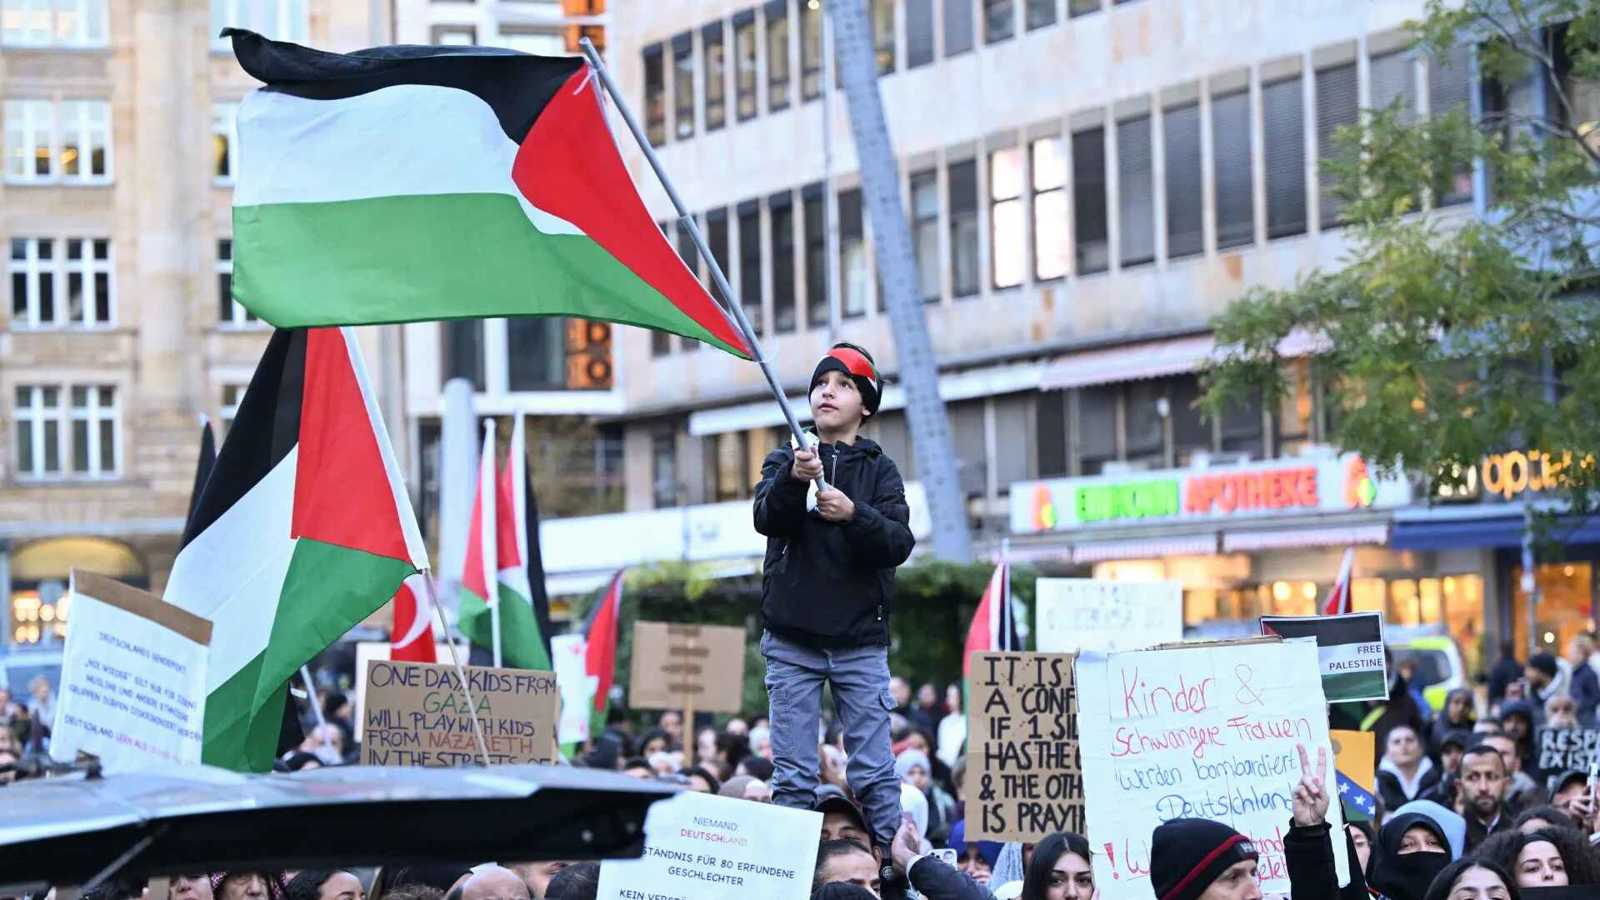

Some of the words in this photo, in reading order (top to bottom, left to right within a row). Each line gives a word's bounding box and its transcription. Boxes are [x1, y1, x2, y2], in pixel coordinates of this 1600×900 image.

[1184, 466, 1319, 513] APOTHEKE
[1357, 645, 1382, 654] FREE
[984, 656, 1021, 686] IT
[1033, 657, 1063, 688] IS
[1329, 659, 1384, 671] PALESTINE
[370, 663, 420, 688] ONE
[468, 669, 513, 693] KIDS
[514, 673, 557, 696] FROM
[1121, 666, 1213, 720] Kinder
[1234, 664, 1265, 706] &
[423, 691, 492, 716] GAZA
[984, 687, 1010, 714] A
[368, 709, 408, 730] WILL
[409, 712, 456, 733] PLAY
[459, 717, 493, 735] WITH
[498, 718, 535, 737] KIDS
[990, 716, 1011, 739] IF
[1028, 714, 1043, 739] 1
[366, 730, 421, 748] FROM
[1110, 725, 1227, 759] Schwangere
[1227, 714, 1312, 741] Frauen
[1541, 729, 1600, 751] RESP
[368, 749, 389, 765] IN
[392, 751, 432, 766] THE
[984, 741, 1032, 771] HAS
[1034, 741, 1071, 770] THE
[1192, 750, 1298, 780] bombardiert
[1539, 750, 1600, 770] EXIST
[979, 773, 996, 801] &
[1001, 774, 1041, 798] THE
[982, 803, 1006, 834] IS
[667, 866, 744, 886] GESCHLECHTER
[696, 853, 716, 866] FÜR
[720, 859, 734, 869] 80
[737, 862, 796, 879] ERFUNDENE
[619, 888, 645, 900] KEIN
